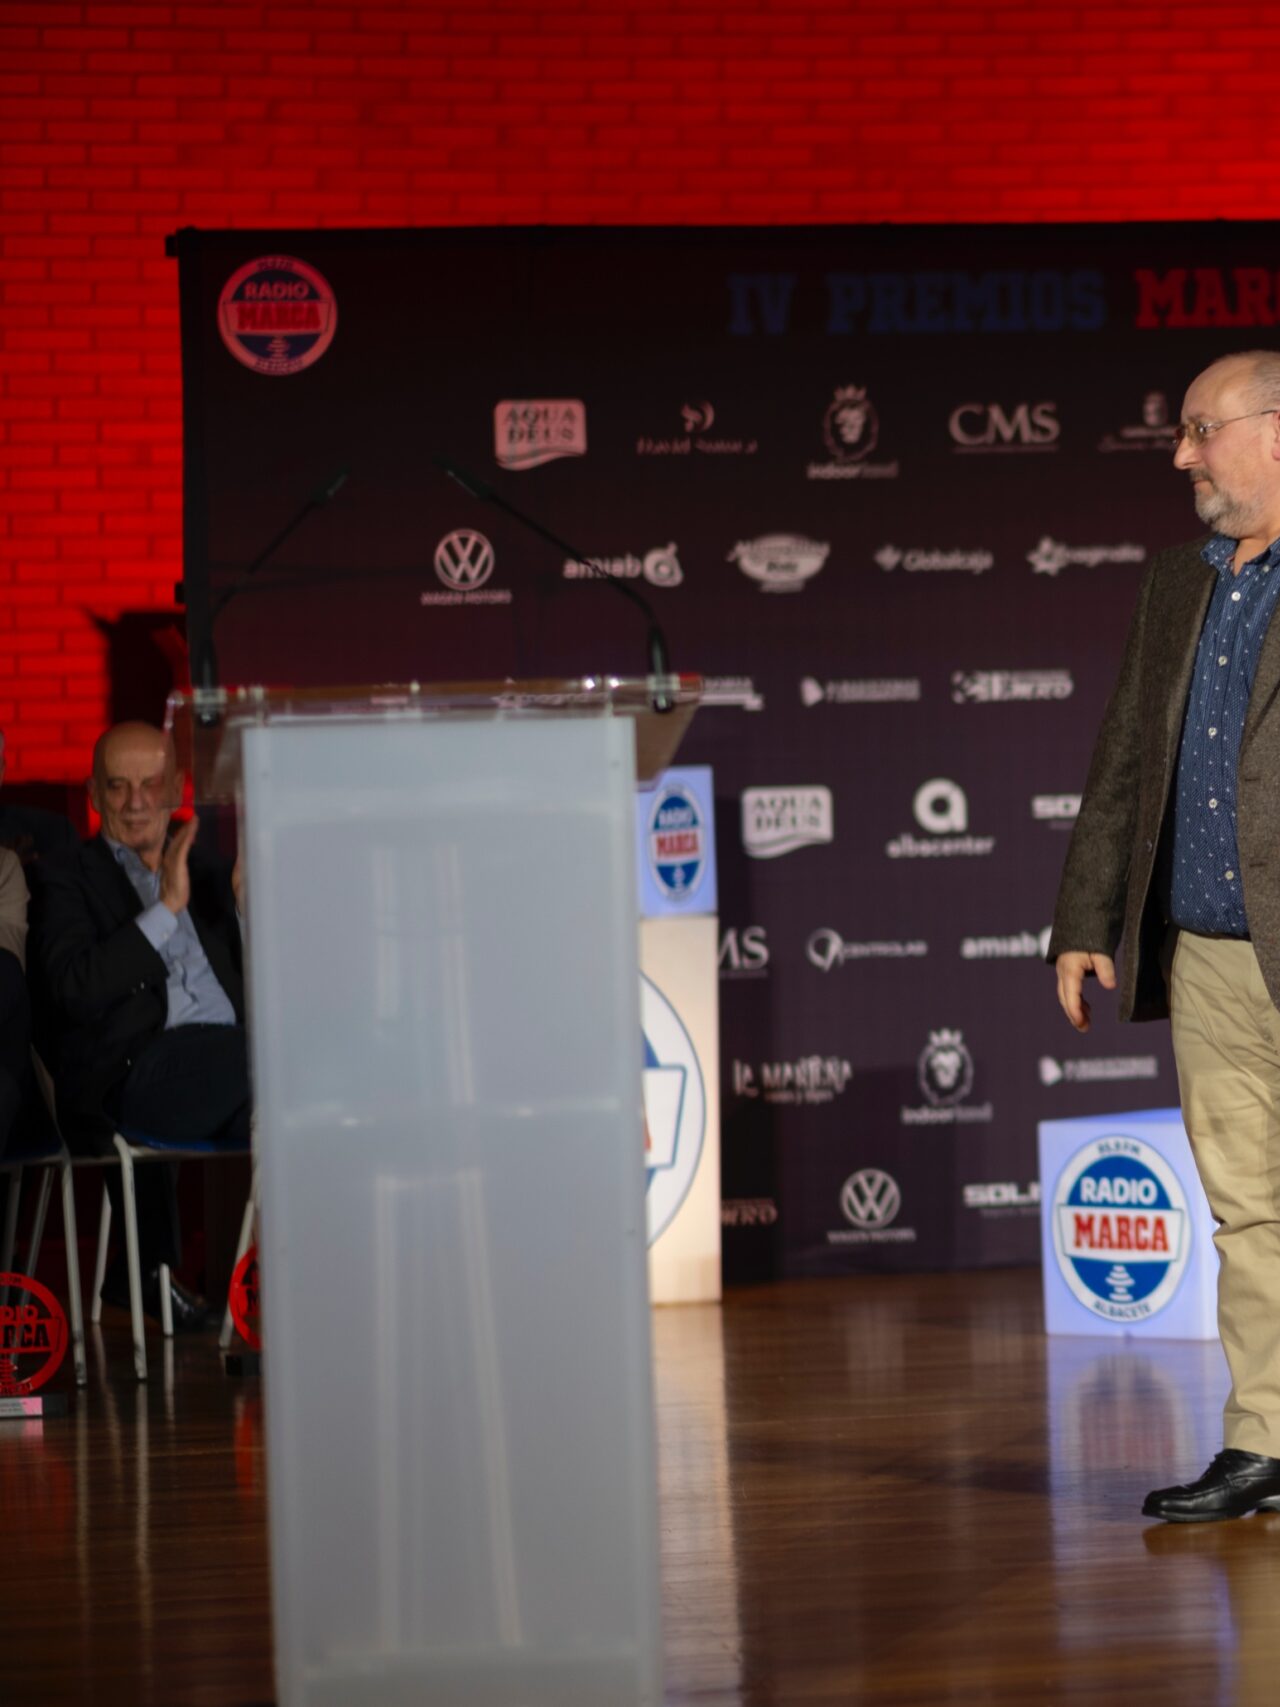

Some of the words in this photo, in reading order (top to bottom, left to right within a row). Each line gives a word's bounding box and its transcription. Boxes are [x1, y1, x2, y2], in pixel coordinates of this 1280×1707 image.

[244, 281, 309, 300] RADIO
[728, 273, 797, 335] IV
[825, 269, 1107, 334] PREMIOS
[948, 401, 1061, 446] CMS
[1080, 1176, 1158, 1206] RADIO
[1073, 1212, 1169, 1253] MARCA
